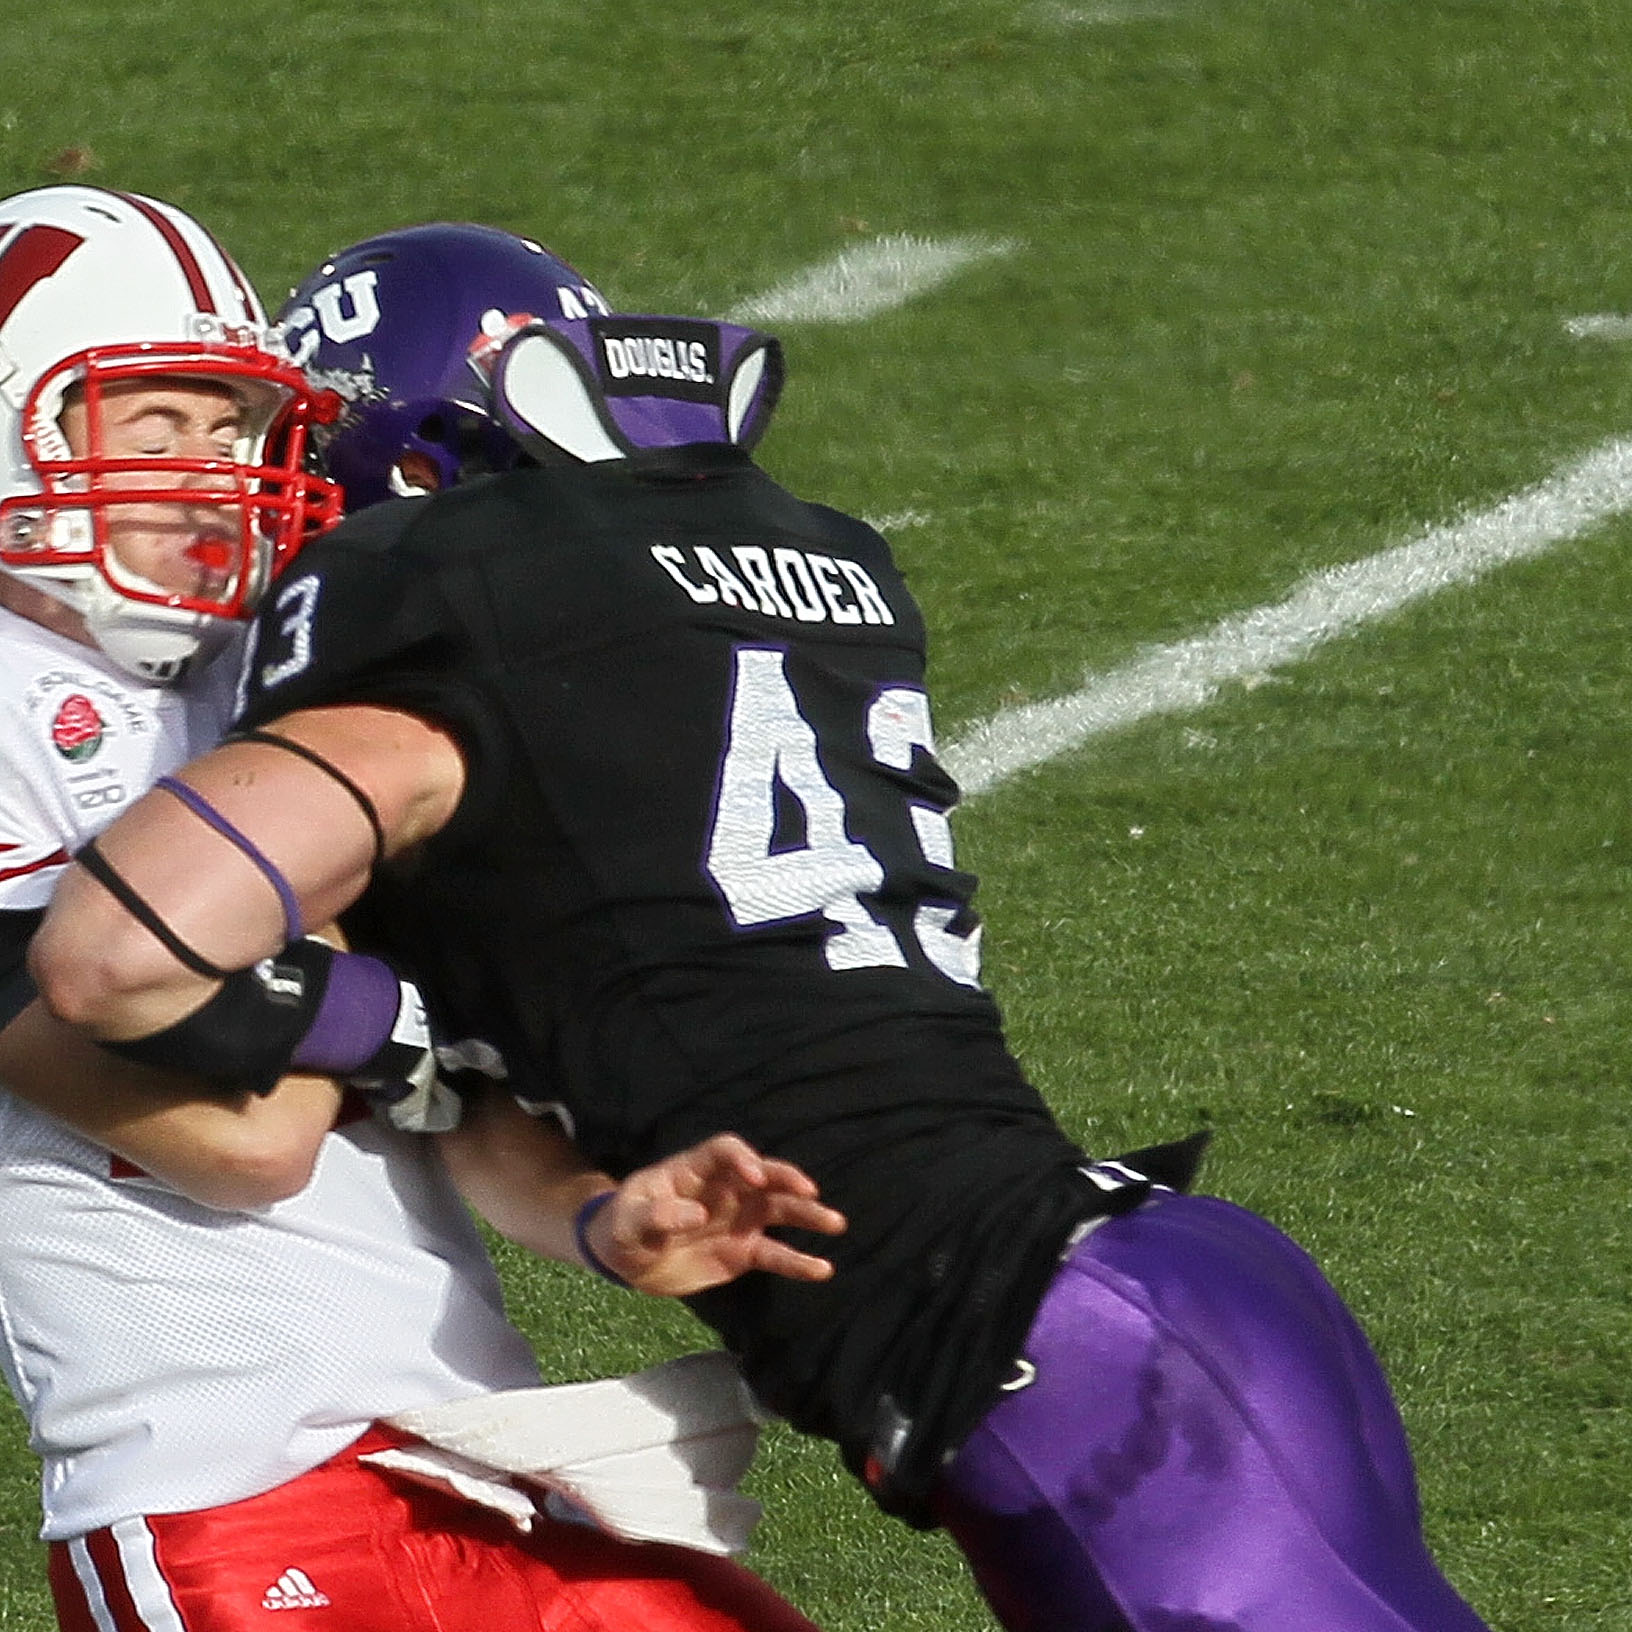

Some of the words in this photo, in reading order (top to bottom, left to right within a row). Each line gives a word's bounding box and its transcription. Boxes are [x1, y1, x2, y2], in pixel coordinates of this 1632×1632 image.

[266, 270, 381, 366] CU
[650, 544, 895, 626] CARDER
[704, 646, 983, 990] 43
